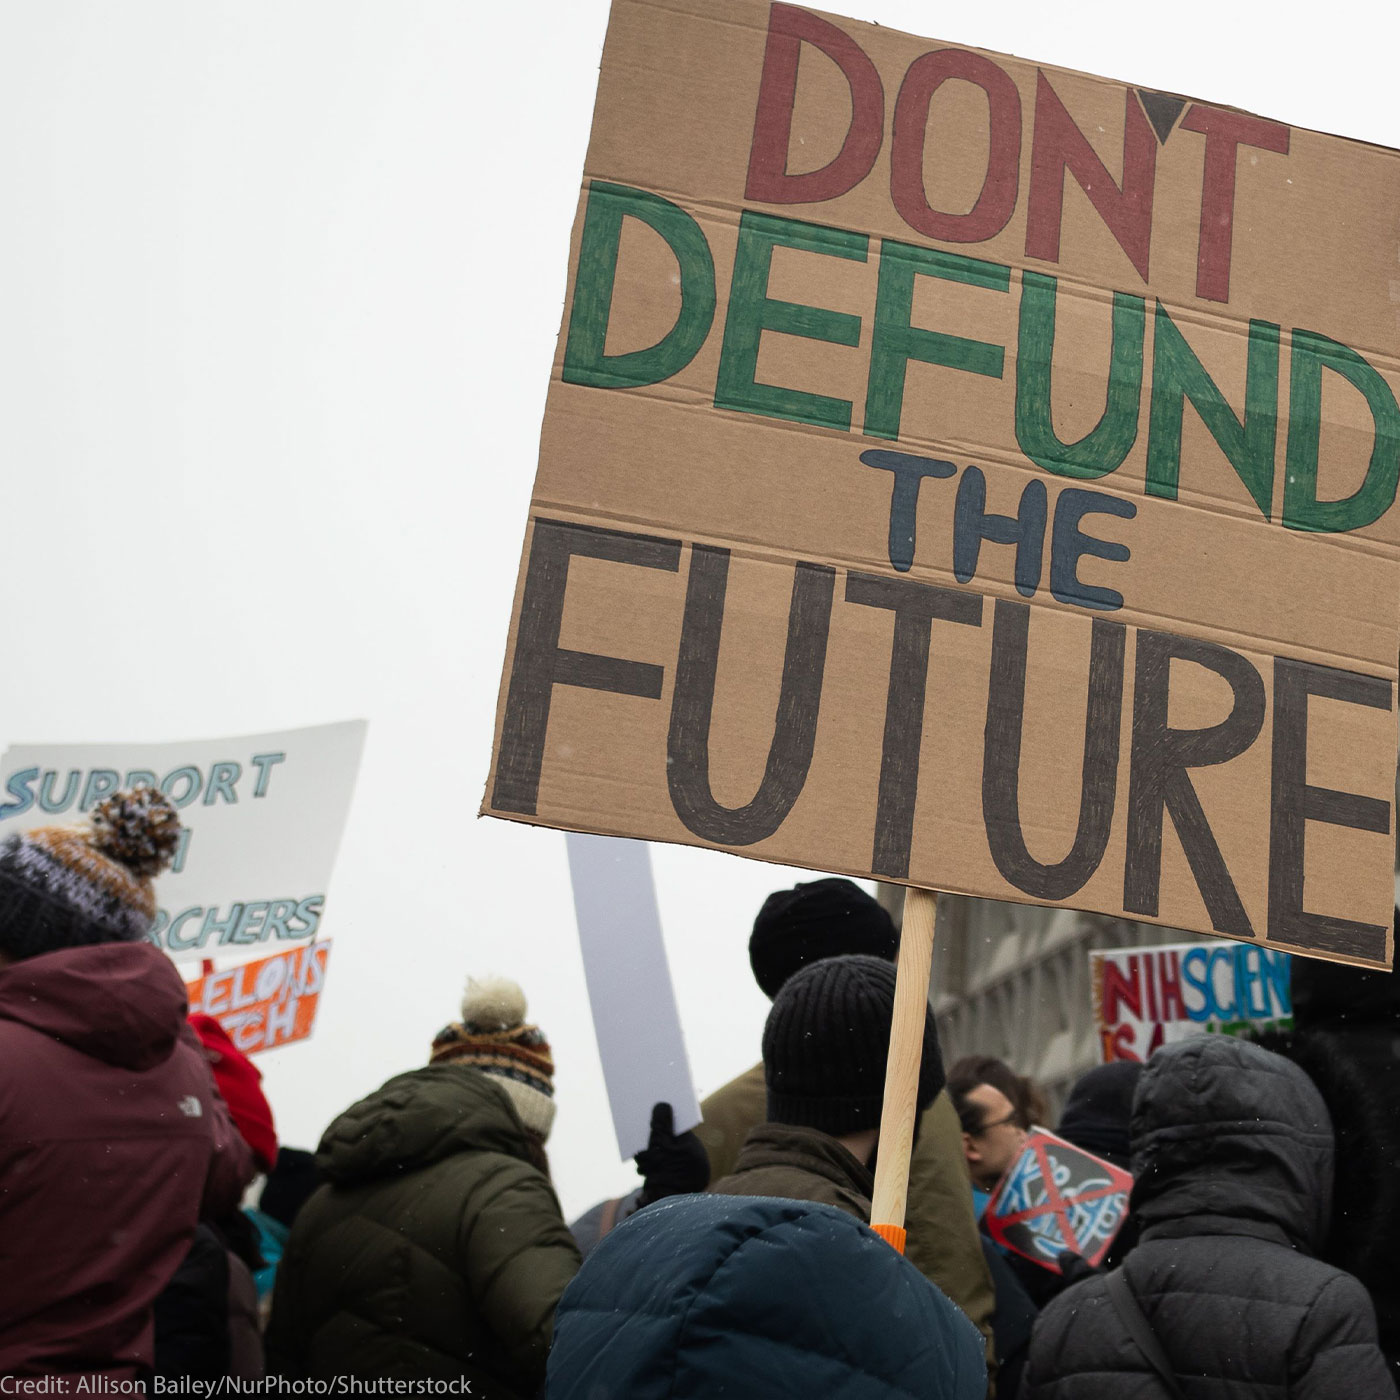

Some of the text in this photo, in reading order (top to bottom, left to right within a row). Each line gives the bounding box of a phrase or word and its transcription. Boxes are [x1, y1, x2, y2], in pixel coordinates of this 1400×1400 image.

[744, 1, 1290, 304] DON'T
[859, 449, 1137, 611] THE
[490, 515, 1393, 962] FUTURE
[149, 895, 325, 952] RCHERS
[189, 942, 332, 1015] ELONS
[1103, 943, 1292, 1024] NIH SCIEN
